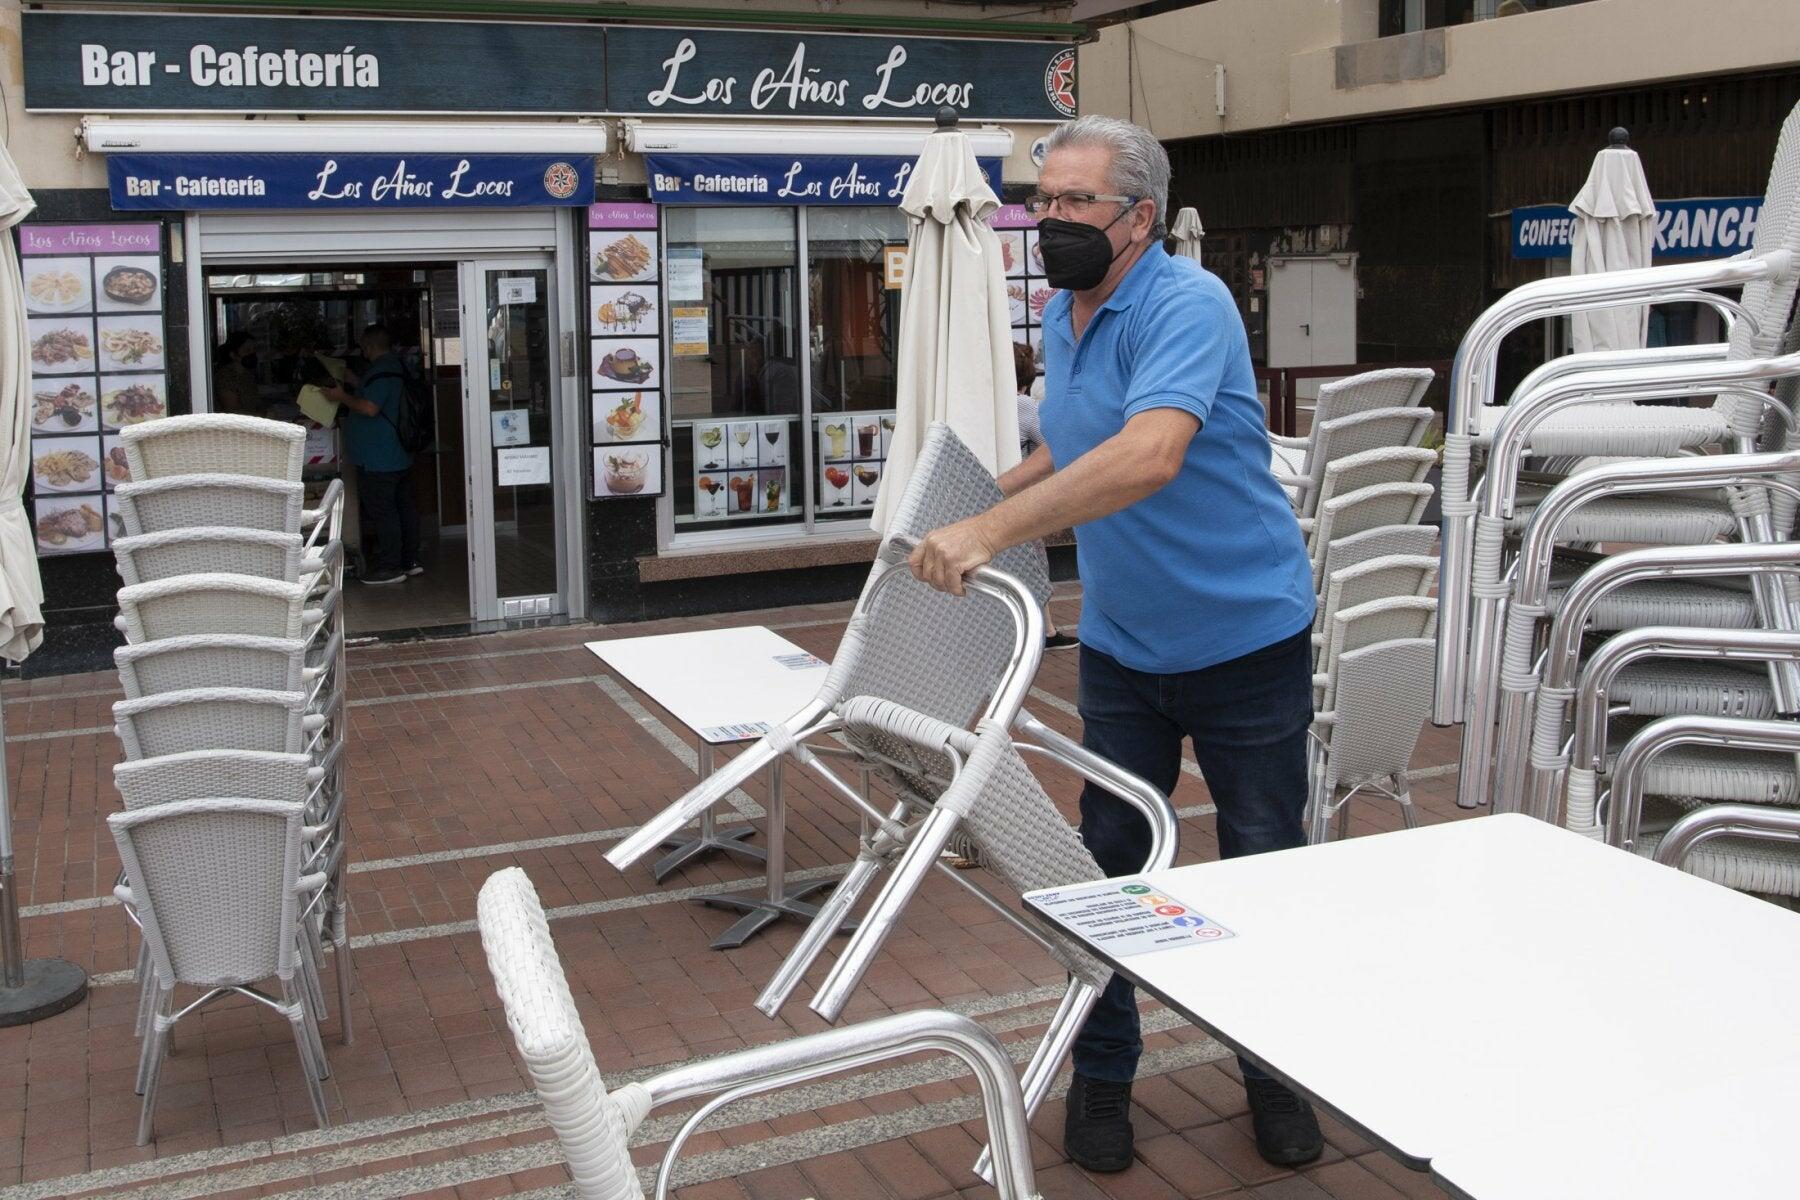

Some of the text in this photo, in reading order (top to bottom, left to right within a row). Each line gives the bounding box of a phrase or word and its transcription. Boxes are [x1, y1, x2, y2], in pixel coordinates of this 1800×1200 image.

[82, 45, 156, 86] Bar
[191, 45, 379, 87] Cafetería
[648, 38, 974, 111] Los Años Locos
[126, 176, 161, 196] Bar
[176, 176, 266, 196] Cafetería
[308, 159, 363, 201] Los
[372, 159, 434, 201] Años
[442, 159, 514, 199] Locos
[655, 173, 681, 192] Bar
[694, 174, 768, 193] Cafetería
[778, 161, 823, 198] Los
[830, 162, 881, 199] Años
[29, 229, 152, 249] Los Años Locos
